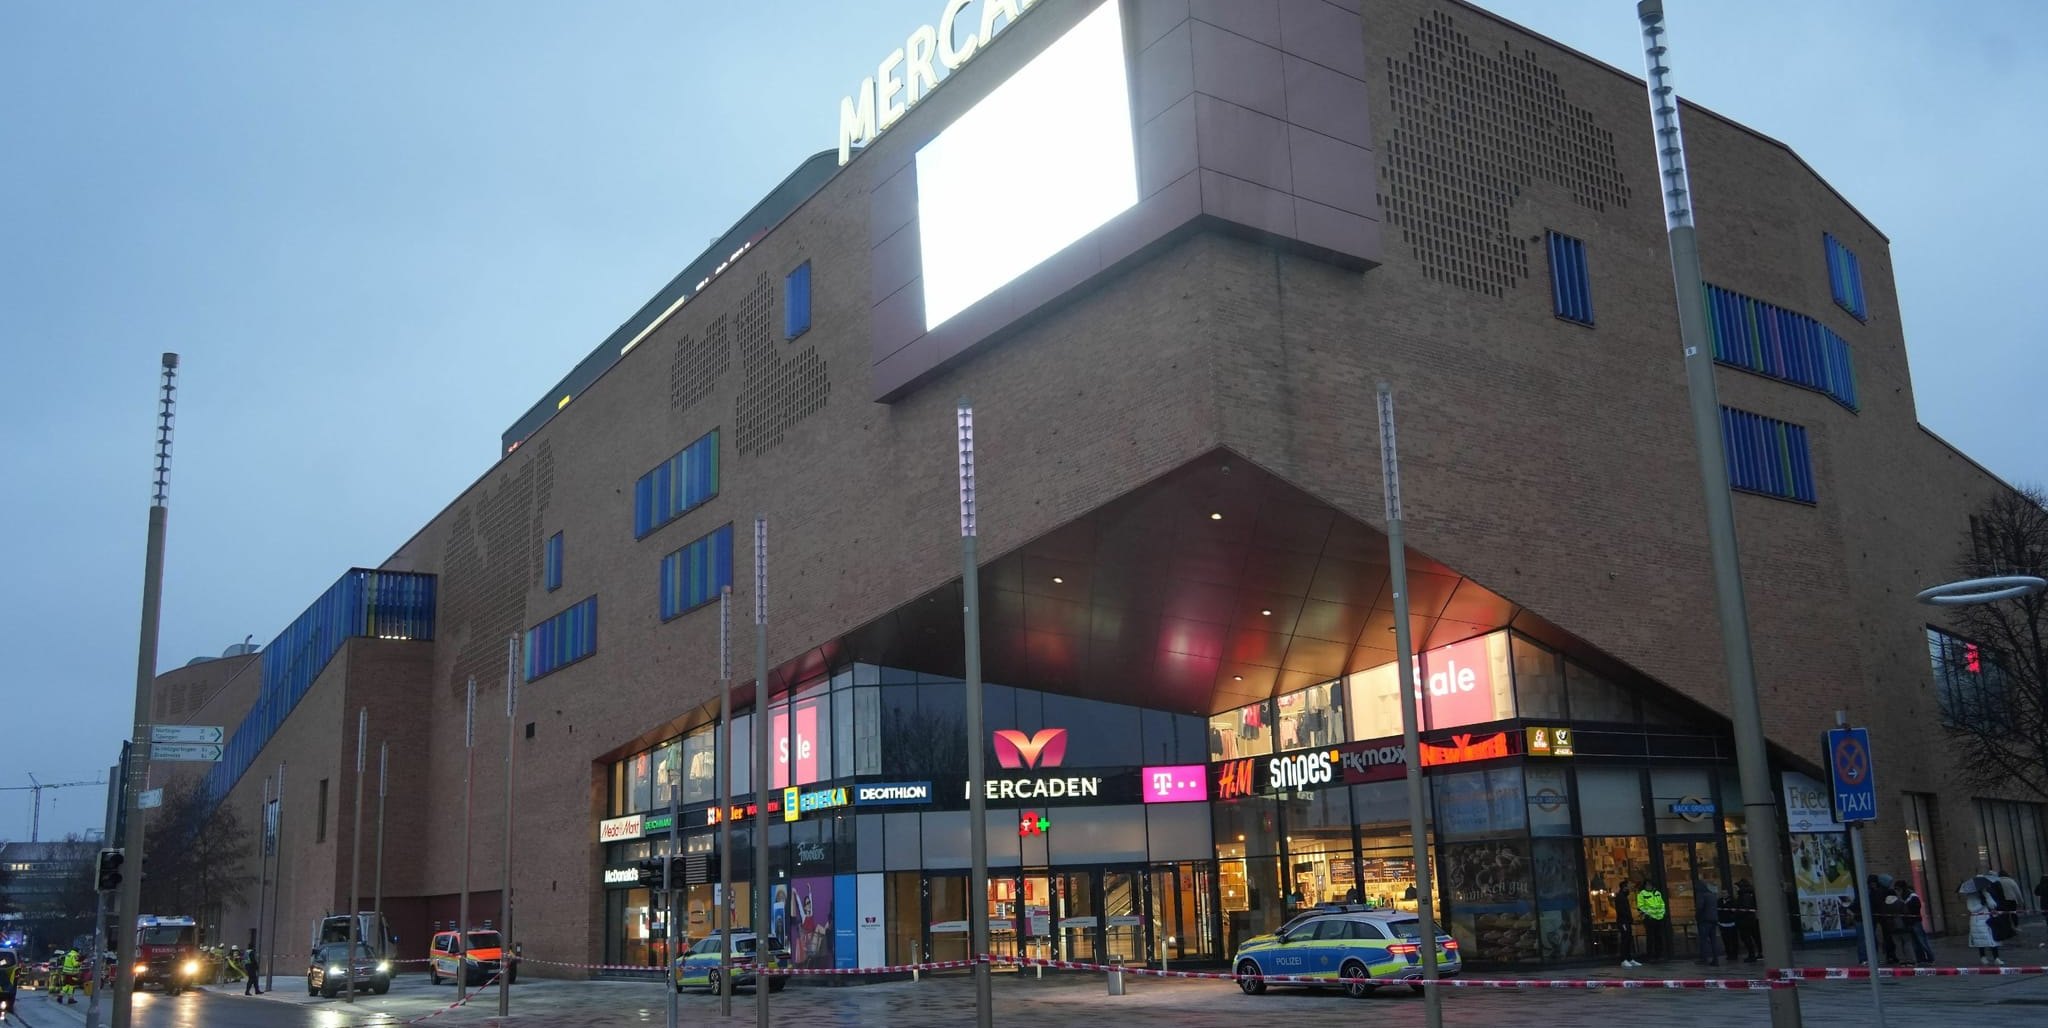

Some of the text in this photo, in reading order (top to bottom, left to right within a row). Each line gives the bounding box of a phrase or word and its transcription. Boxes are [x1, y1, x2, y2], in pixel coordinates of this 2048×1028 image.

[839, 0, 1040, 166] MERCA
[1219, 758, 1254, 799] H&M
[1270, 751, 1332, 792] snipes
[800, 787, 848, 813] EDEKA
[860, 786, 927, 801] DECATHLON
[1840, 792, 1872, 812] TAXI
[1275, 956, 1302, 966] POLIZEI
